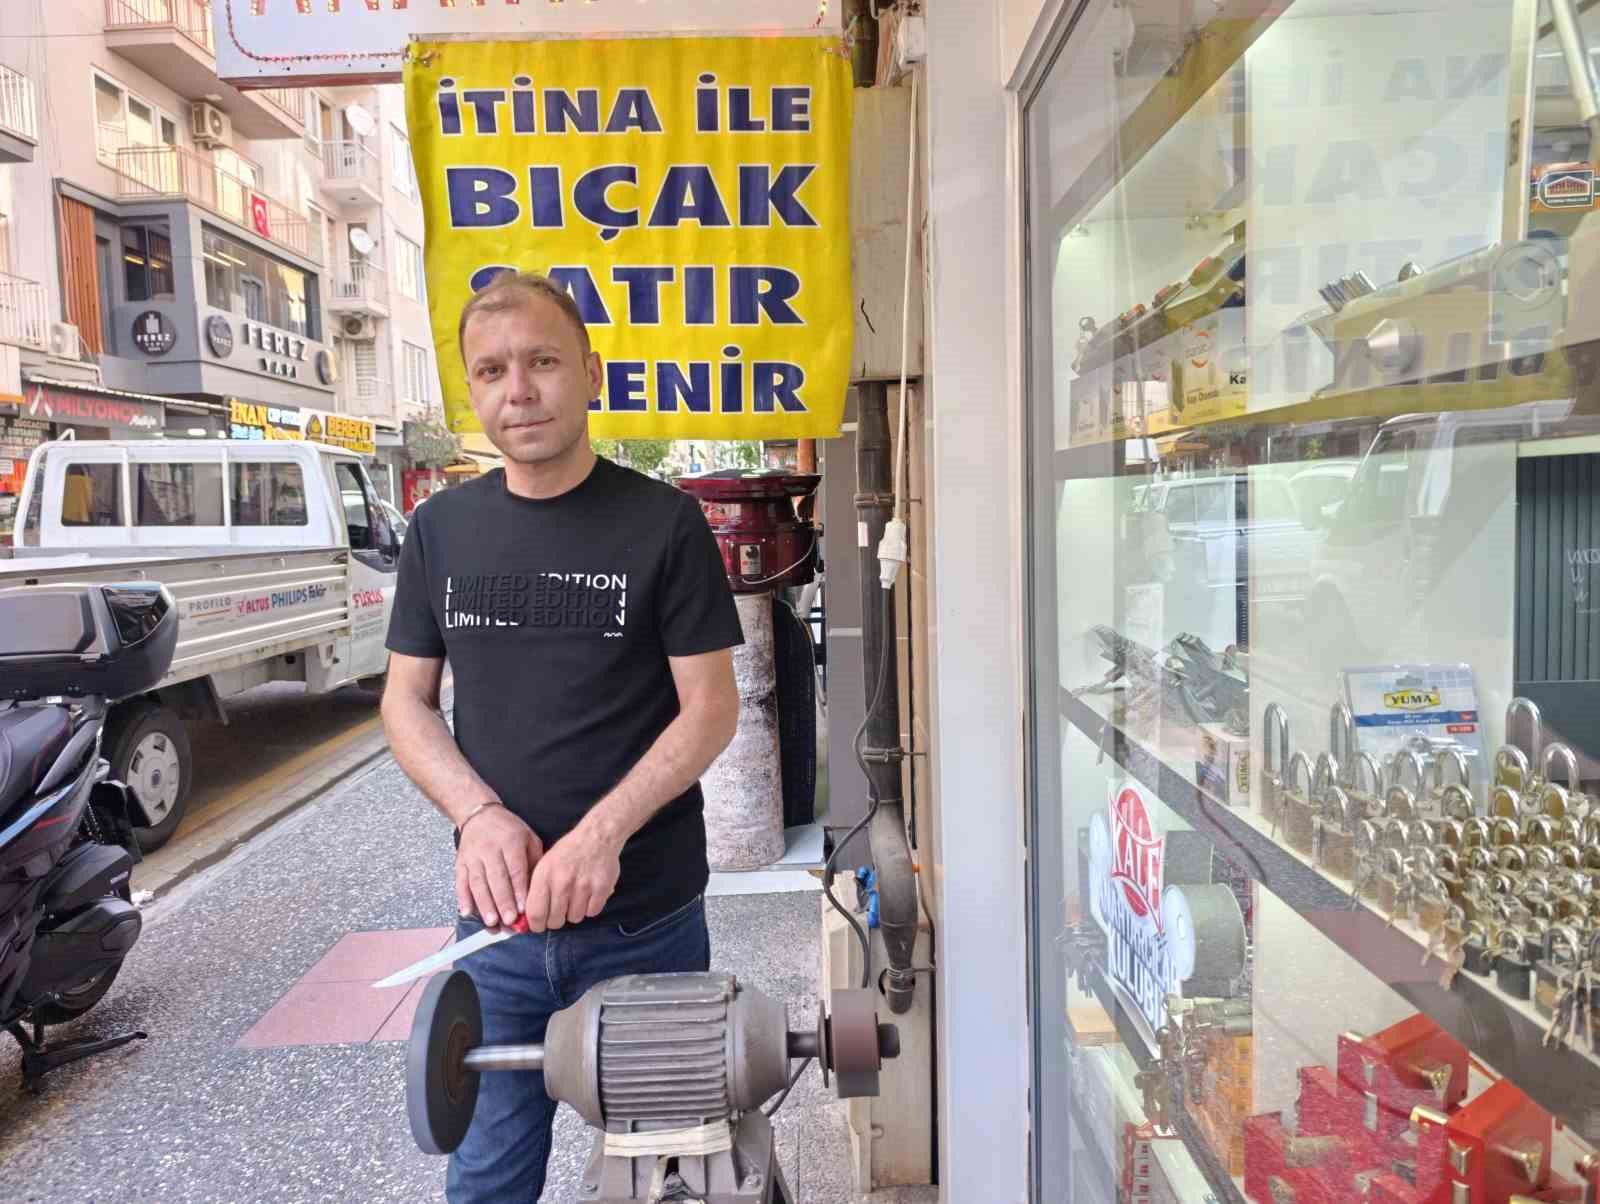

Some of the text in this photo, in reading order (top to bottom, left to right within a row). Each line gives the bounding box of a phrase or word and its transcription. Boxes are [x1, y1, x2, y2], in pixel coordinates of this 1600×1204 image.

[438, 72, 811, 136] İTİNA İLE
[446, 164, 820, 242] BIÇAK
[137, 333, 170, 343] FEREZ
[245, 322, 309, 362] FEREZ
[588, 345, 807, 413] ENİR
[446, 572, 628, 593] LIMITED EDITION
[246, 597, 270, 614] ALTUS
[271, 588, 308, 608] PHILIPS
[445, 610, 526, 628] LIMITED
[1391, 694, 1433, 706] YUMA
[1109, 792, 1167, 930] KALE
